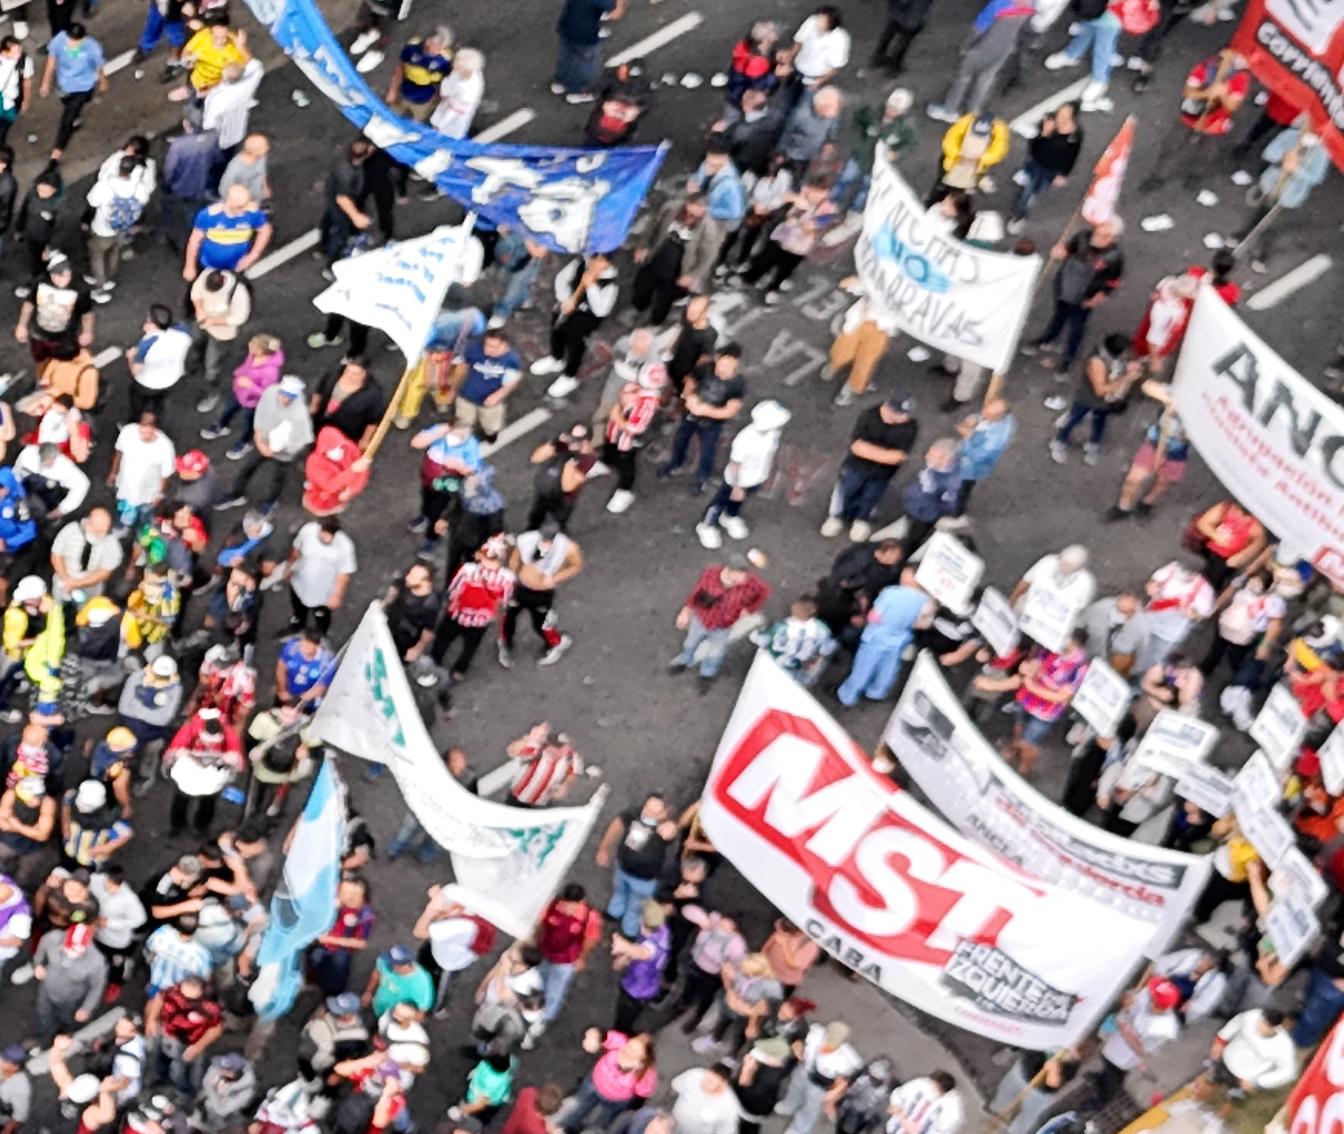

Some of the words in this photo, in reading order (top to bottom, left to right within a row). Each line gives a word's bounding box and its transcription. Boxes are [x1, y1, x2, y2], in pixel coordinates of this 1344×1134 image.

[726, 734, 1042, 950] MST
[805, 918, 884, 985] CABA
[958, 938, 1046, 1004] FRENTE
